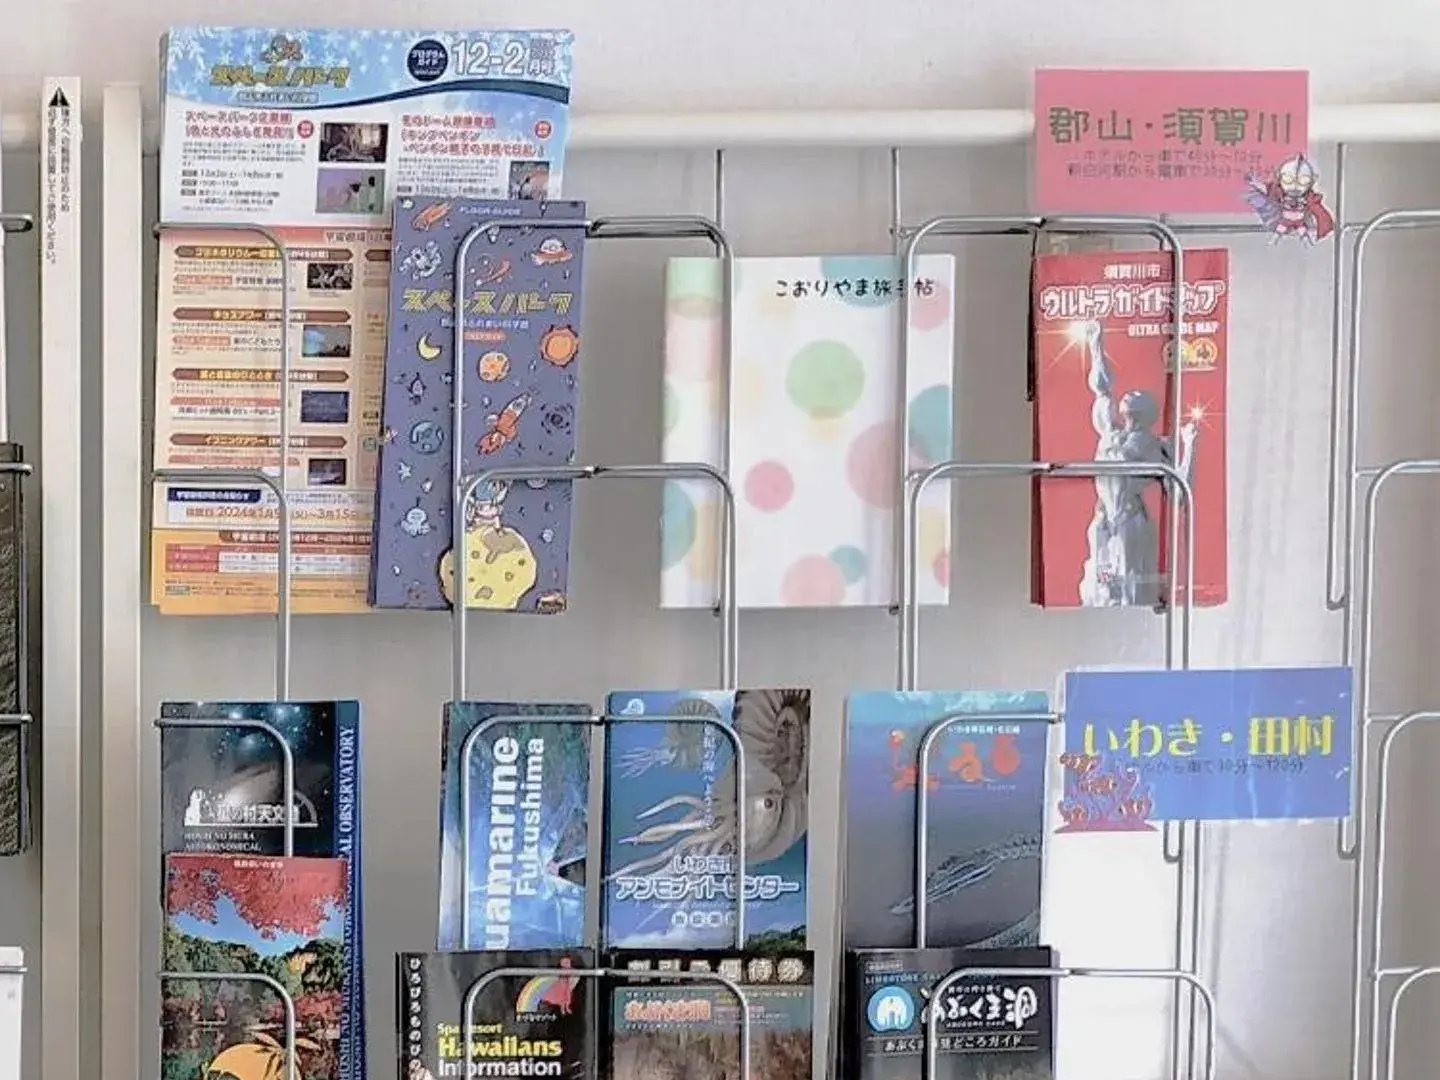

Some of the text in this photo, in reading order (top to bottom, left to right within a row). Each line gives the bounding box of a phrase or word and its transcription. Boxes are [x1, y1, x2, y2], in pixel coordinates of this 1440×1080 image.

[1048, 106, 1291, 146] 郡山・須賀川
[1083, 715, 1335, 758] いわき・田村
[515, 738, 545, 896] Fukushima
